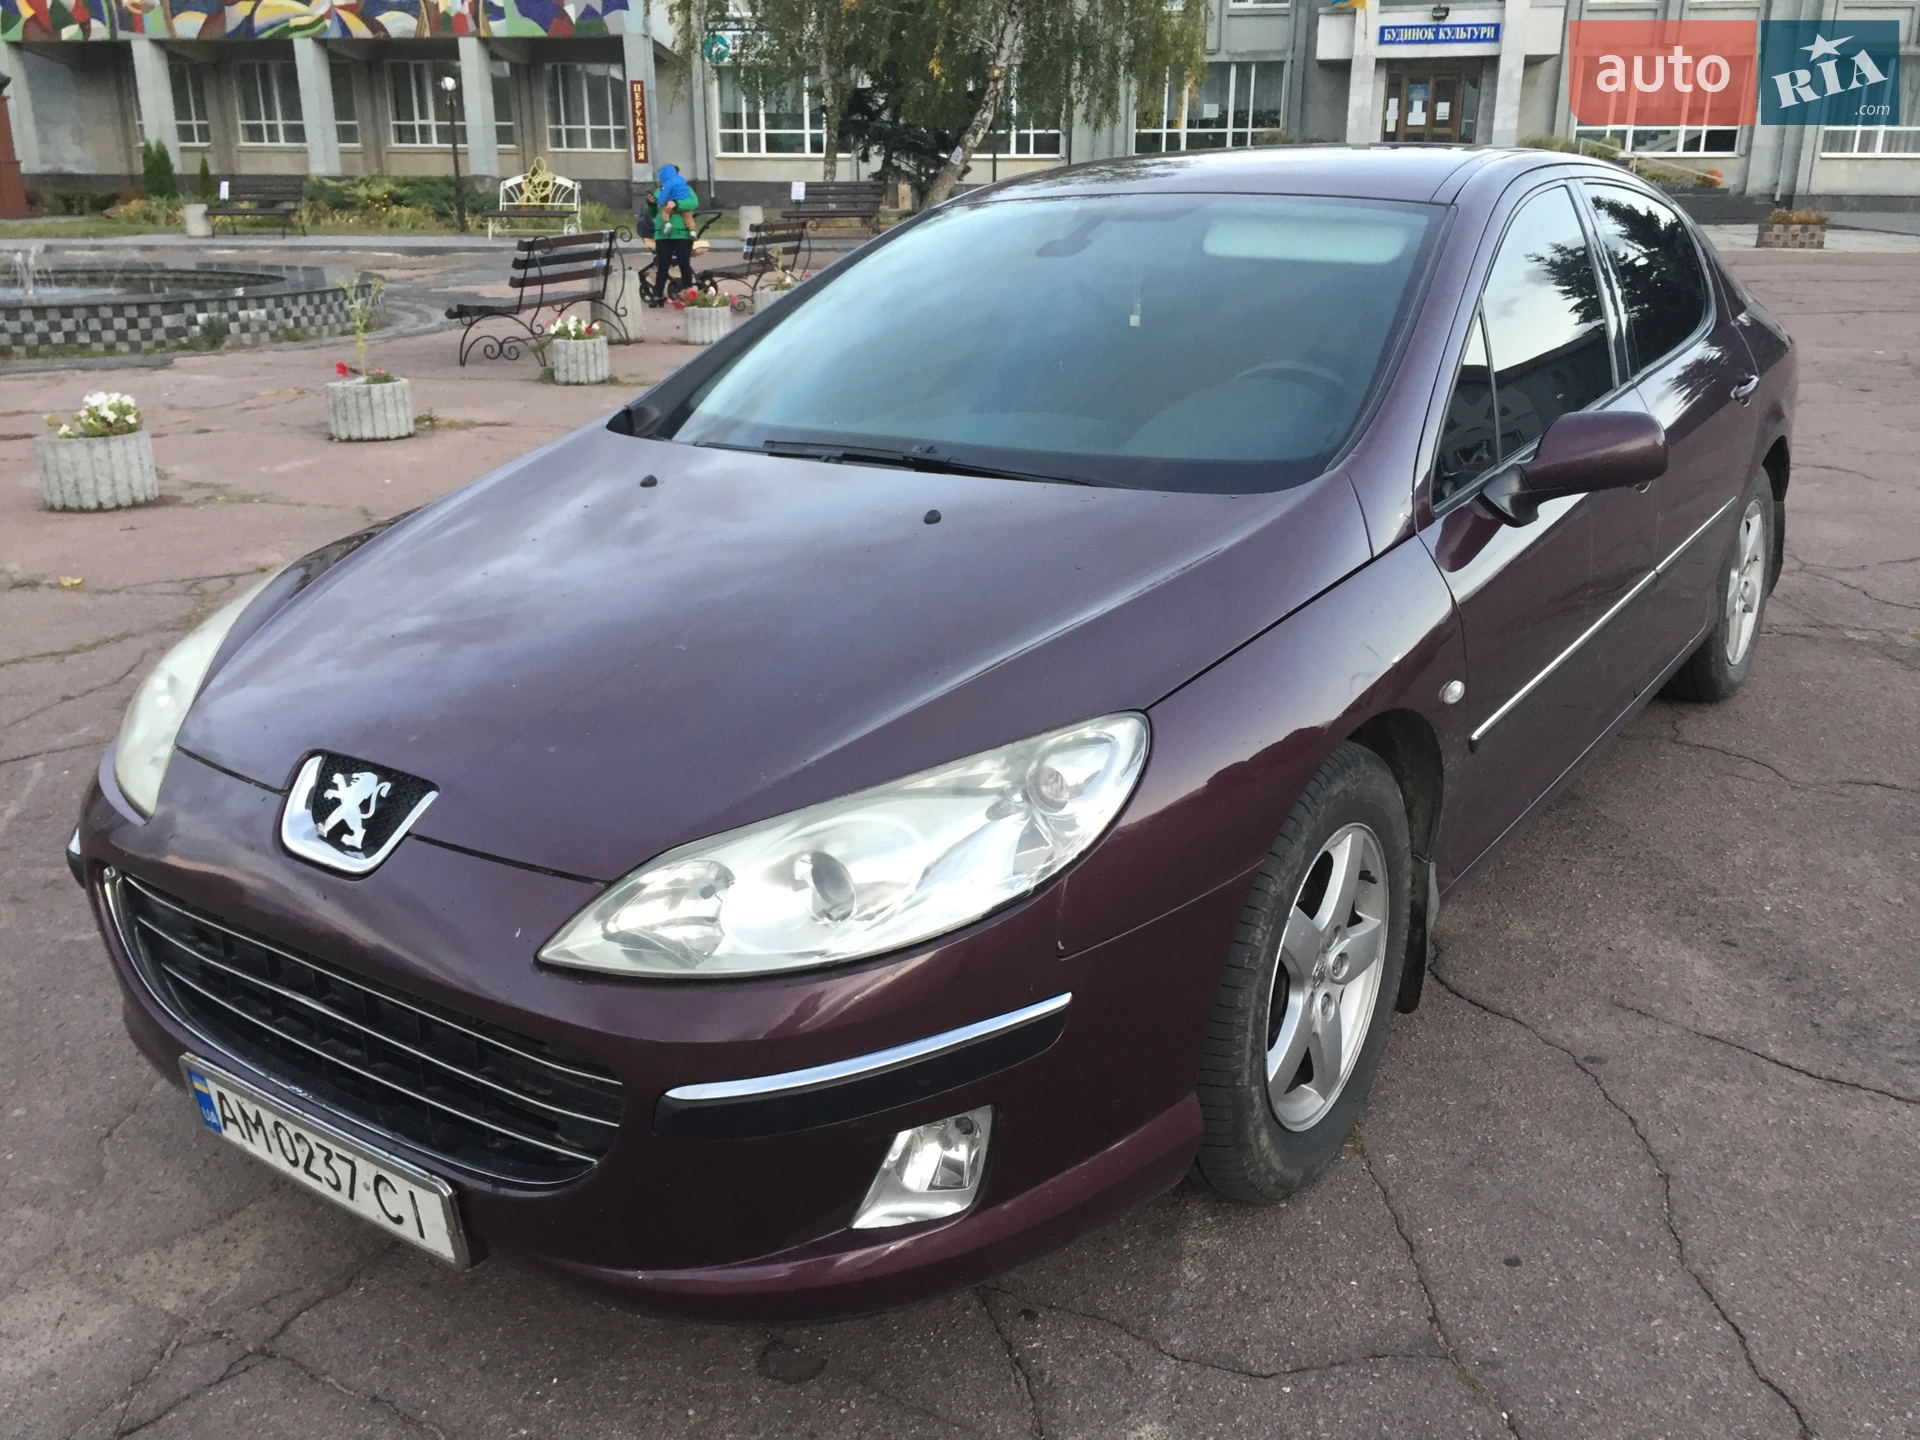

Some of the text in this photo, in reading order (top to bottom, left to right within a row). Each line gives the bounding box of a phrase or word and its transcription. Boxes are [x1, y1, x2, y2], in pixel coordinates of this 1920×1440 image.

[1384, 27, 1495, 42] БУДИНОК КУЛЬТУРИ
[633, 84, 645, 160] ПЕРУКАРНЯ
[202, 1107, 218, 1126] UA
